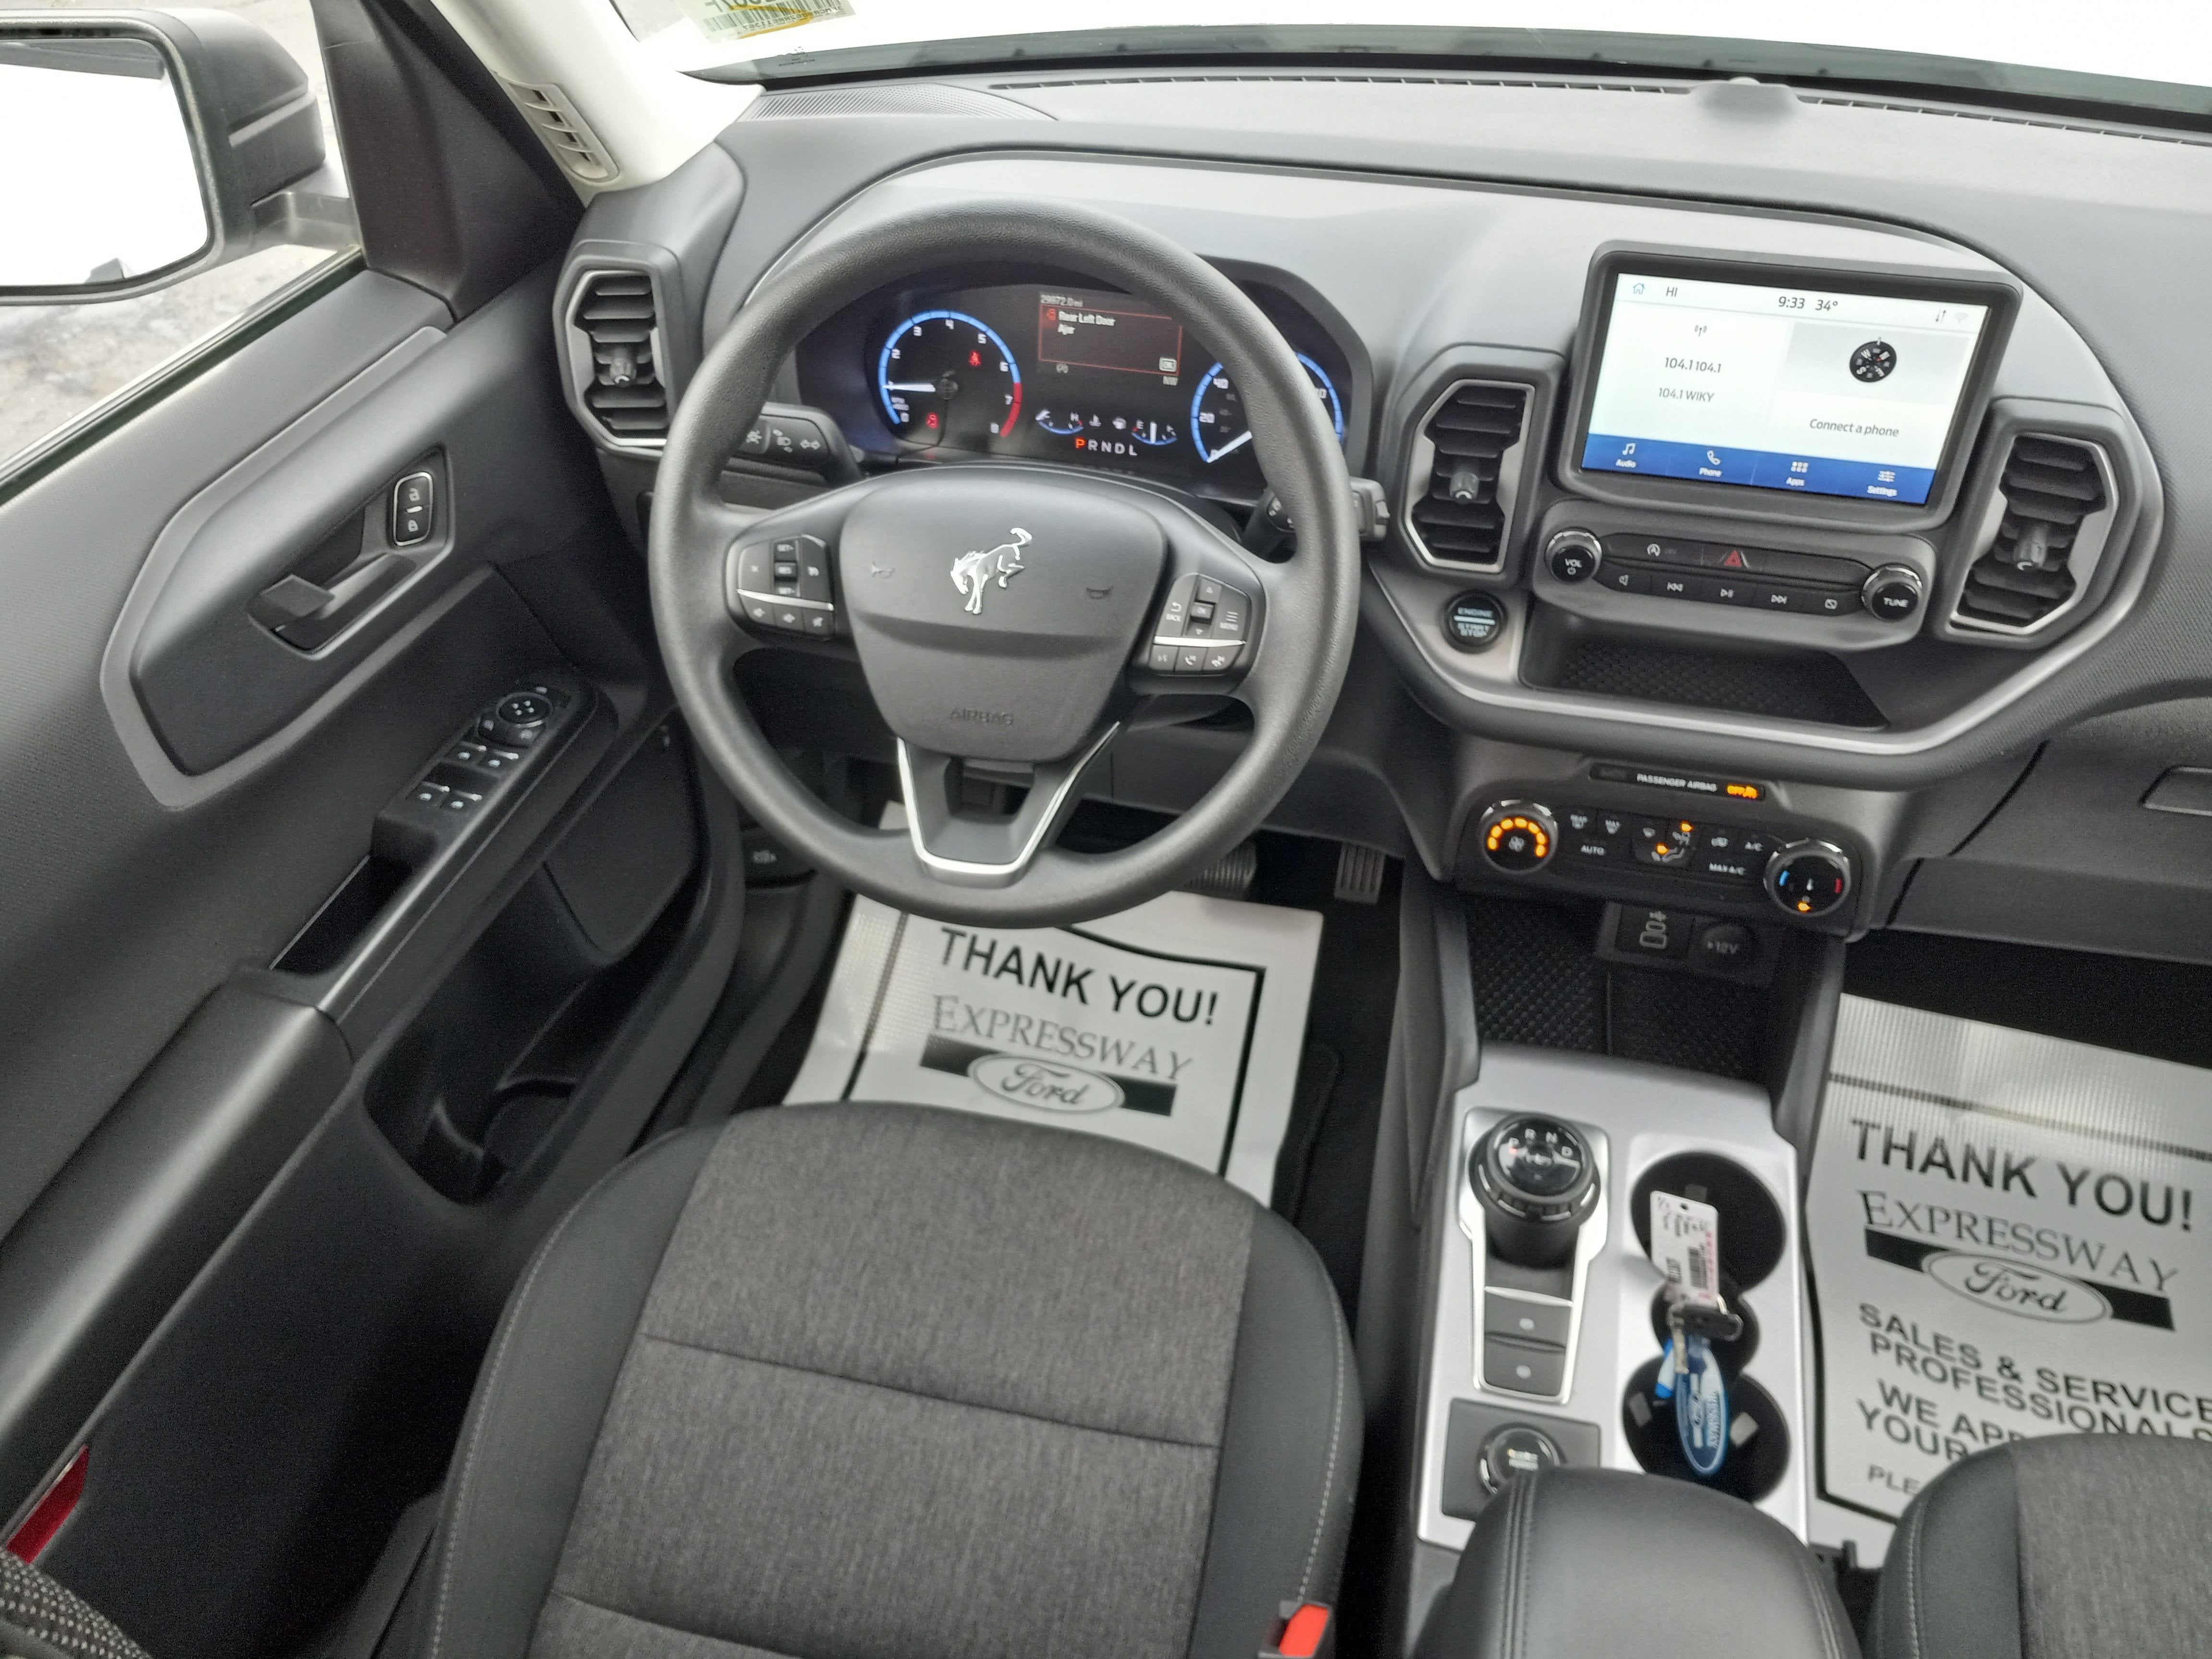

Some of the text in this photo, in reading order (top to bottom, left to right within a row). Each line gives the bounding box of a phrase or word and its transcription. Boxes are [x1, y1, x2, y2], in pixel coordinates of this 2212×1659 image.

[1666, 287, 1677, 298] HI
[1778, 296, 1838, 312] 9:33 34°
[945, 319, 954, 330] 4
[913, 326, 922, 337] 3
[977, 333, 986, 344] 5
[891, 348, 901, 359] 2
[999, 361, 1009, 372] 6
[1665, 357, 1721, 373] 104.1 104.1
[1004, 394, 1013, 405] 7
[1659, 387, 1714, 403] 104.1 WIKY
[1199, 411, 1215, 424] 20
[1810, 419, 1900, 437] Connect a phone
[1615, 459, 1636, 468] Audio
[1699, 467, 1722, 477] Phone
[1867, 485, 1898, 497] Settings
[1565, 558, 1582, 568] VOL
[1883, 596, 1909, 608] TUNE
[1637, 773, 1717, 792] PASSENGER AIRBAG
[1581, 845, 1605, 856] AUTO
[1745, 841, 1764, 852] A/C
[940, 926, 1219, 1026] THANK YOU!
[933, 994, 1194, 1081] EXPRESSWAY
[1001, 1062, 1090, 1105] Ford
[1850, 1118, 2193, 1232] THANK YOU!
[1856, 1190, 2179, 1292] EXPRESSWAY
[1964, 1260, 2068, 1313] Ford
[1859, 1302, 2212, 1424] SALES & SERVICE
[1877, 1378, 1939, 1430] WE
[1856, 1398, 1969, 1461] YOUR
